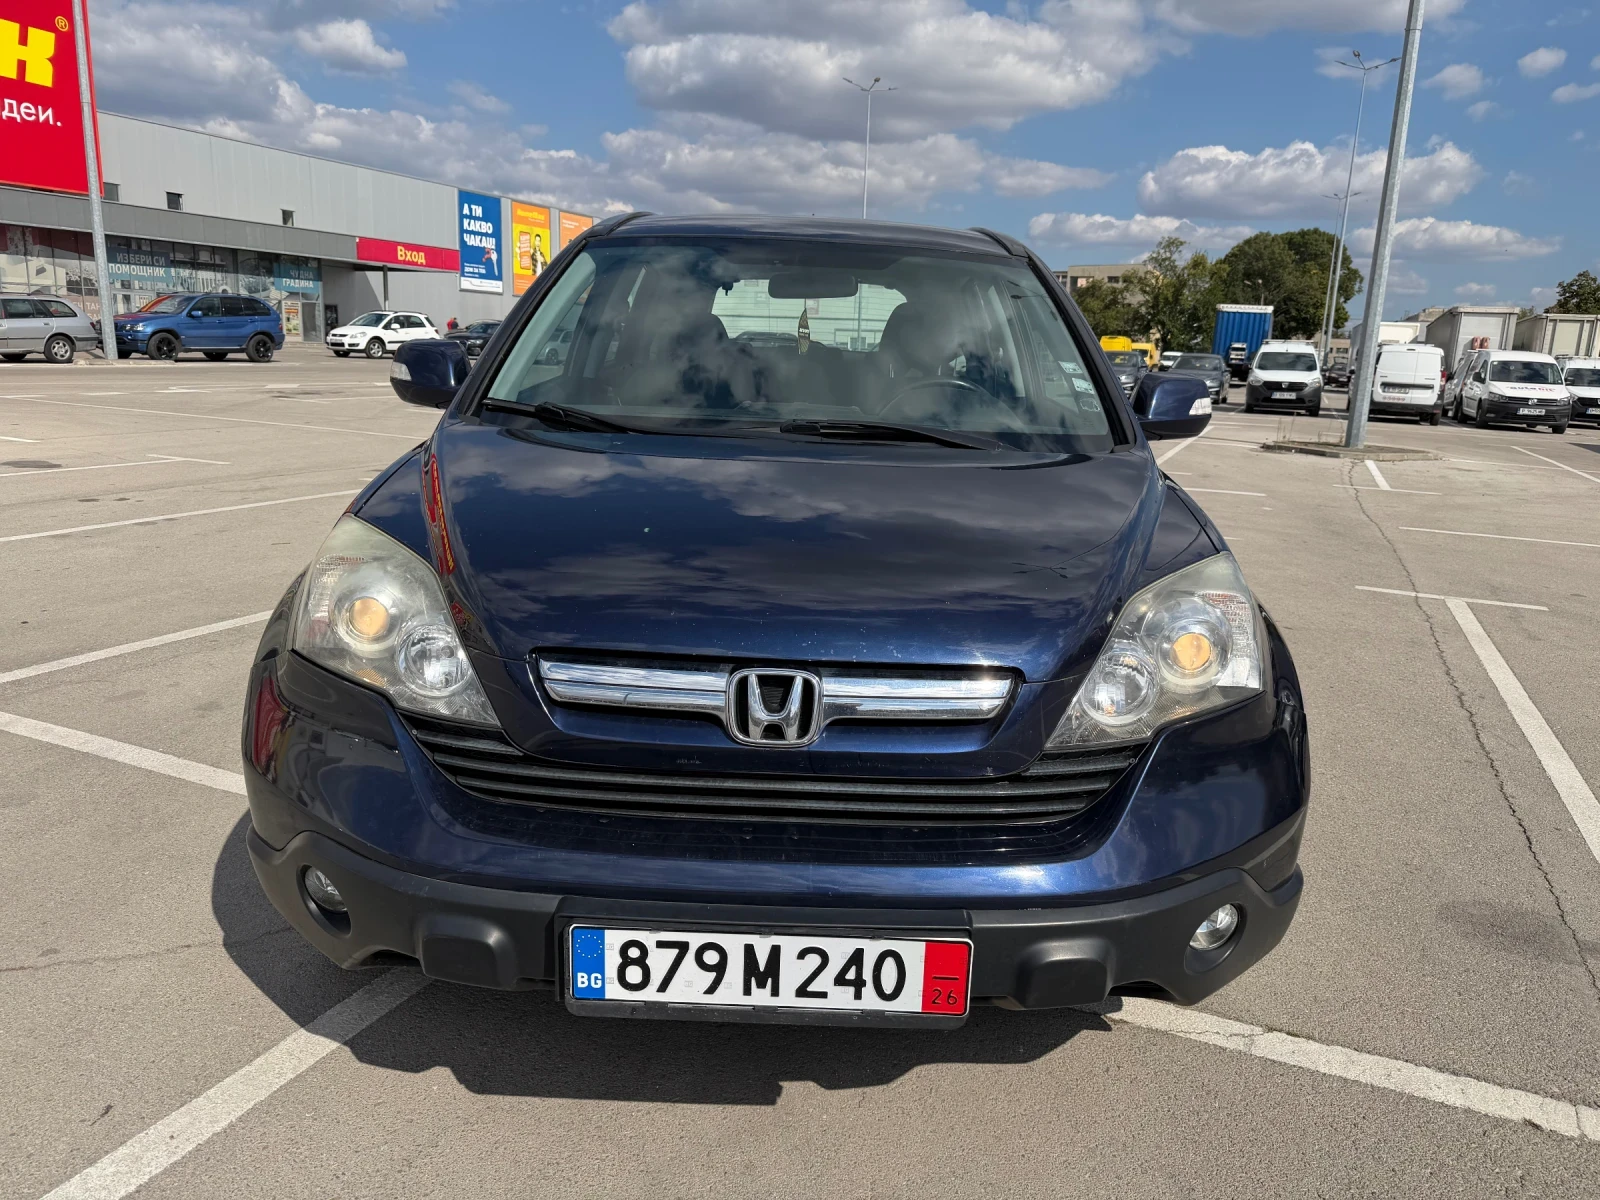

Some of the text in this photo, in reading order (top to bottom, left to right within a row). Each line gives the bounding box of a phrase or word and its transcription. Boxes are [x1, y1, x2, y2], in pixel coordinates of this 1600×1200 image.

[0, 98, 62, 127] деи.
[462, 203, 483, 218] А ТИ
[463, 218, 493, 234] КАКВО
[116, 253, 166, 266] ИЗБЕРИ СИ
[397, 245, 426, 265] Вход
[108, 263, 166, 277] ПОМОЩНИК
[290, 270, 314, 280] ЧУДНА
[282, 278, 314, 288] ГРАДИНА
[577, 972, 602, 989] BG
[931, 988, 959, 1006] 26
